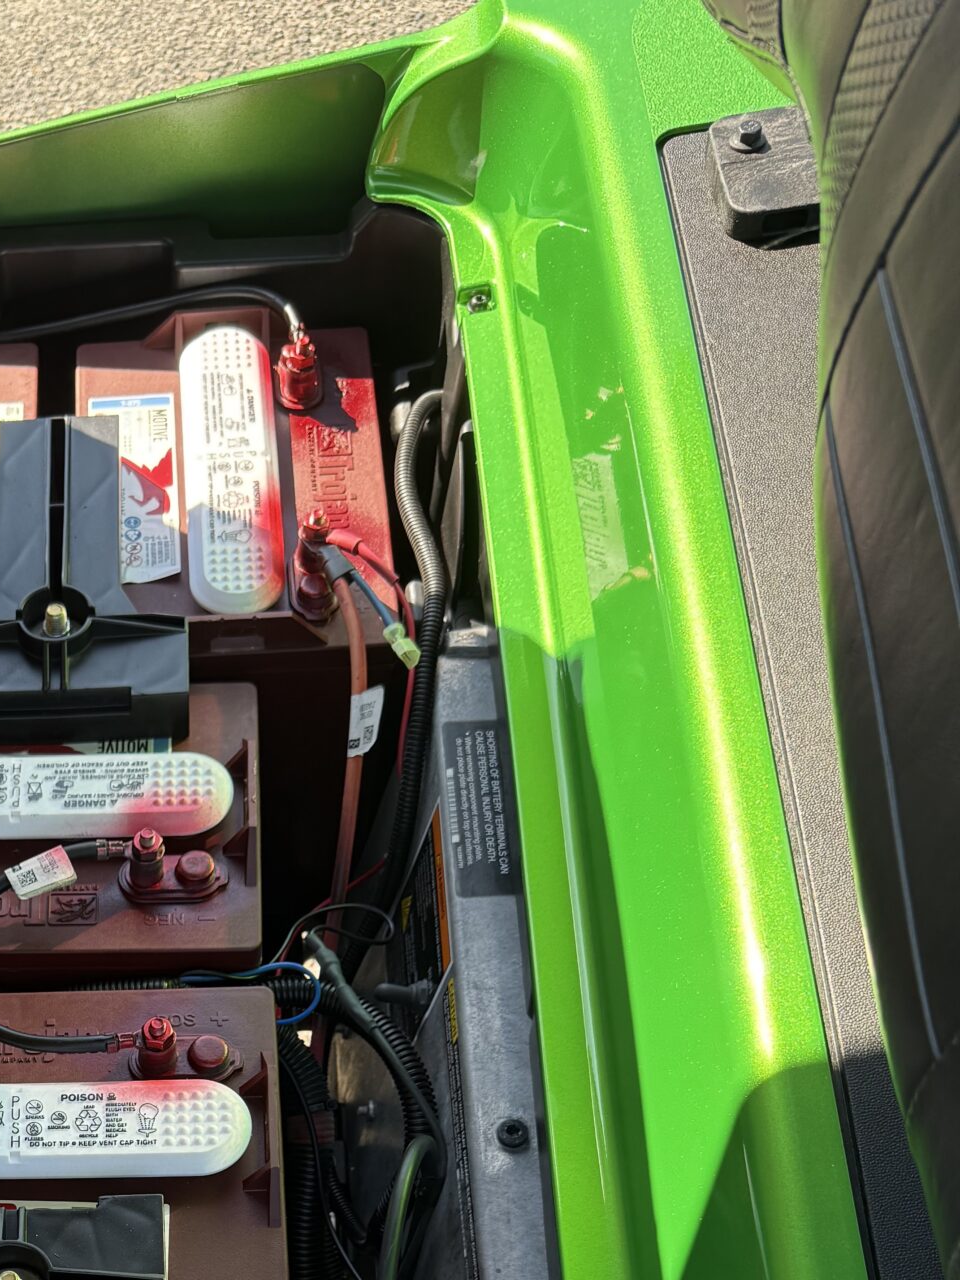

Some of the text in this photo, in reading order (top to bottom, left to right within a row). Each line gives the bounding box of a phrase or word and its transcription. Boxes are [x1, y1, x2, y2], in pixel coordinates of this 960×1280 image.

[153, 409, 168, 442] MOTIVE
[97, 739, 148, 754] MOTIVE
[456, 738, 462, 746] do
[464, 737, 472, 754] When
[475, 731, 485, 755] CAUSE
[456, 758, 466, 773] place
[465, 755, 475, 781] removing
[477, 756, 489, 795] PERSONAL
[12, 764, 21, 807] PUSH
[458, 774, 467, 788] plate
[63, 800, 106, 808] DANGER
[460, 790, 470, 810] directly
[469, 783, 478, 815] component
[482, 797, 492, 822] INJURY
[485, 730, 508, 874] SHORTING OF BATTERY TERMINALS CAN
[462, 821, 471, 830] top
[472, 816, 480, 844] mounting
[484, 824, 493, 835] OR
[60, 1093, 103, 1102] POISON
[10, 1096, 20, 1148] PUSH
